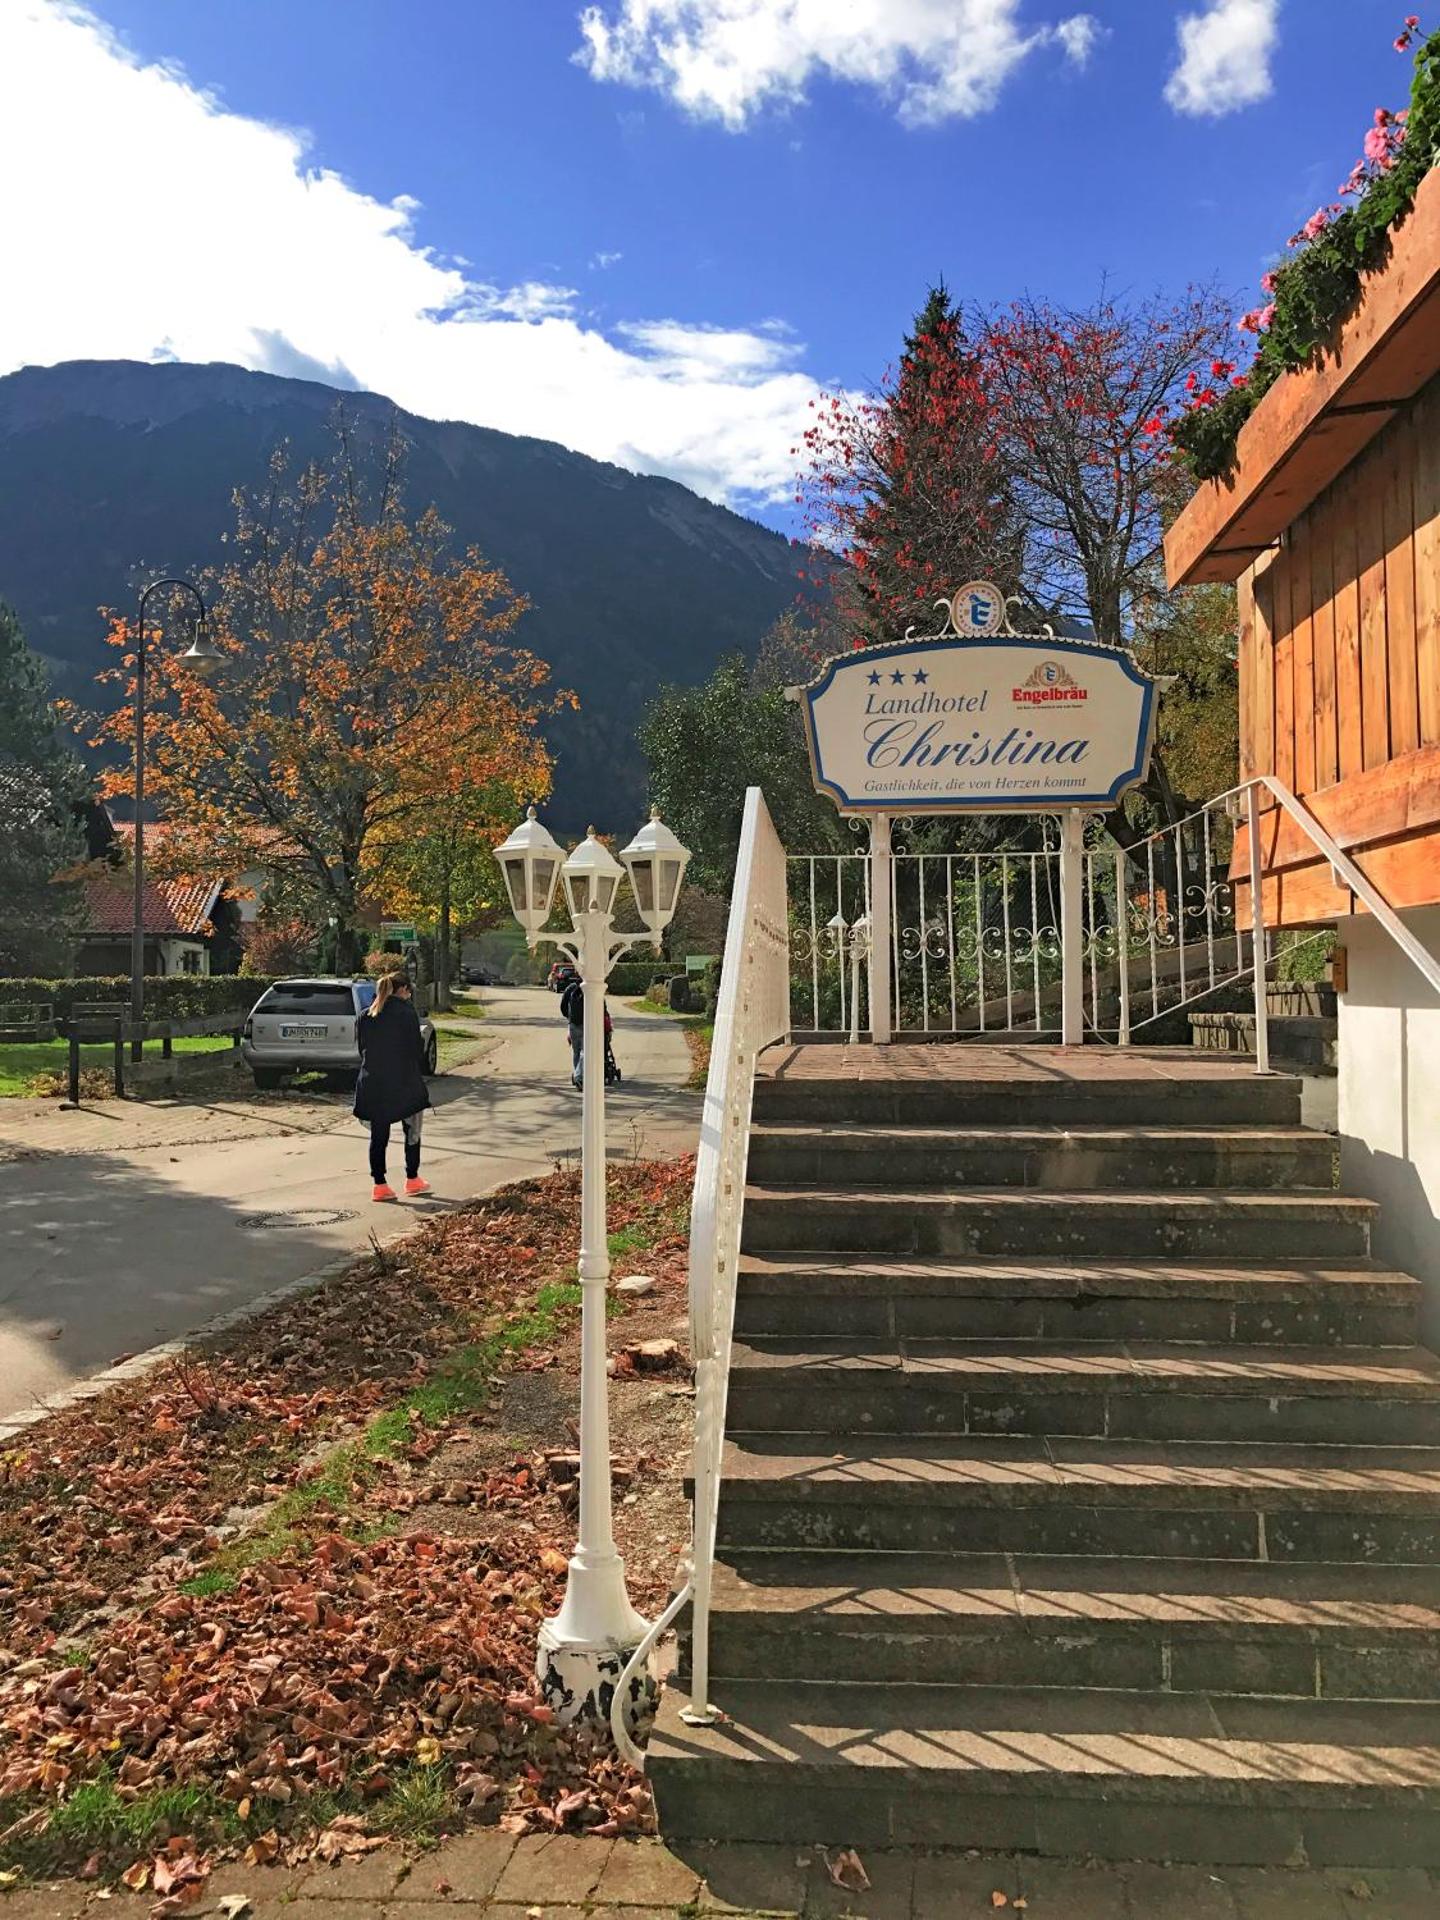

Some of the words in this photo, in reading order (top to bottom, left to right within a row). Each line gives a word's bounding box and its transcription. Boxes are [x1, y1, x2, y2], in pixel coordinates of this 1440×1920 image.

[864, 690, 988, 716] Landhotel
[1012, 686, 1088, 704] Engelbräu
[863, 718, 1090, 769] Christina
[864, 778, 942, 793] Gastlichkeit,
[945, 777, 963, 790] die
[969, 781, 991, 789] von
[995, 777, 1041, 789] Herzen
[1044, 775, 1086, 788] kommt
